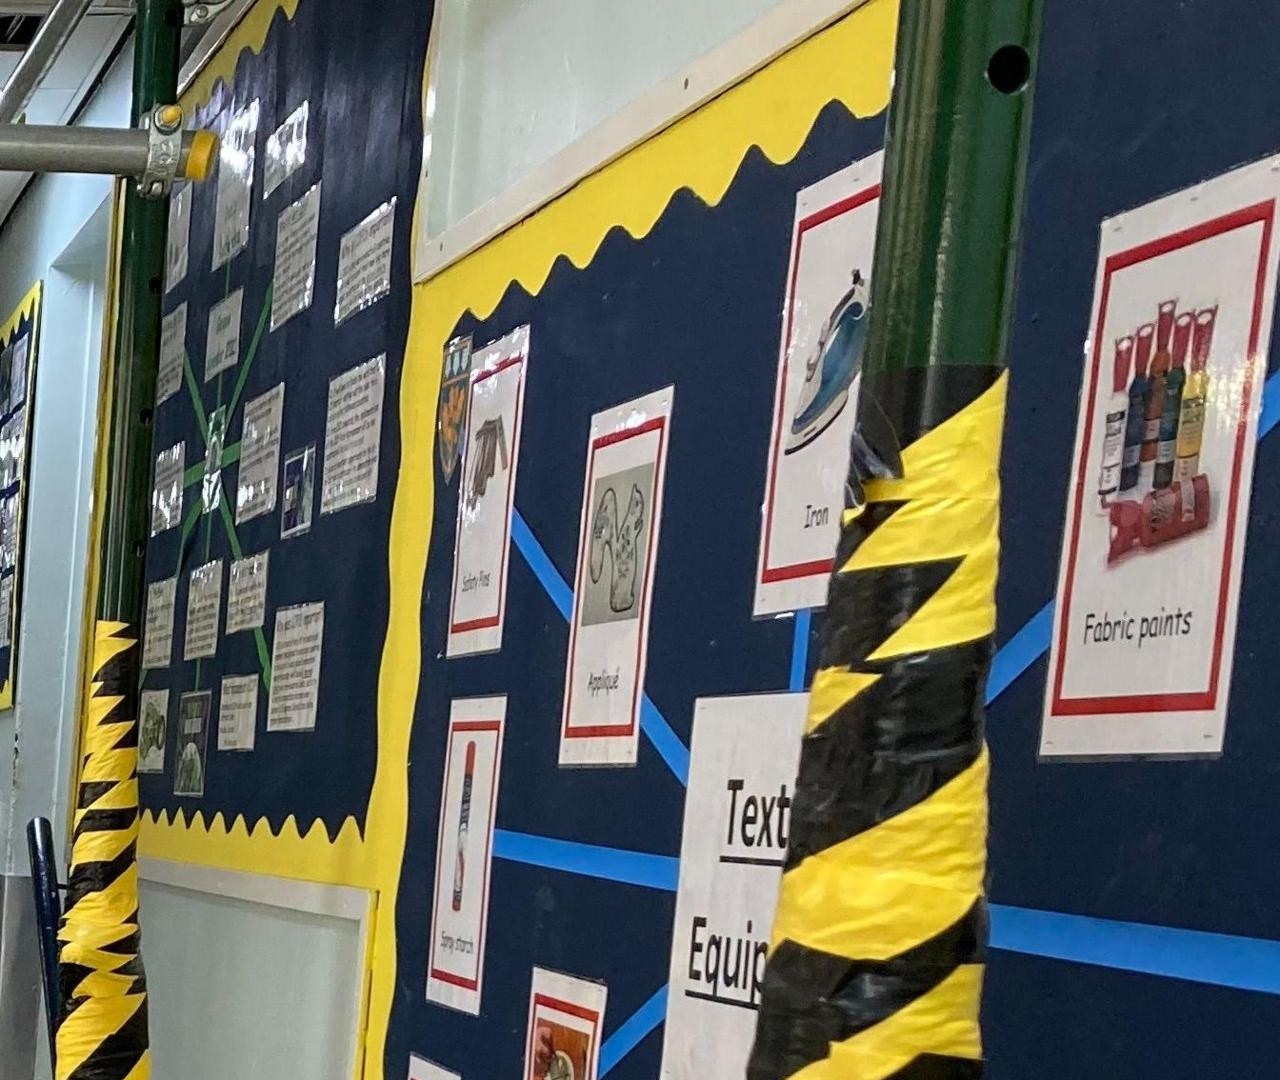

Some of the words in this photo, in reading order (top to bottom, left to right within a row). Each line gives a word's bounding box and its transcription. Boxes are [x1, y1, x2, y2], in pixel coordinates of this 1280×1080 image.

[804, 504, 829, 529] Iron
[1083, 611, 1134, 645] Fabric
[1138, 606, 1192, 649] paints
[587, 665, 620, 698] Appliqué
